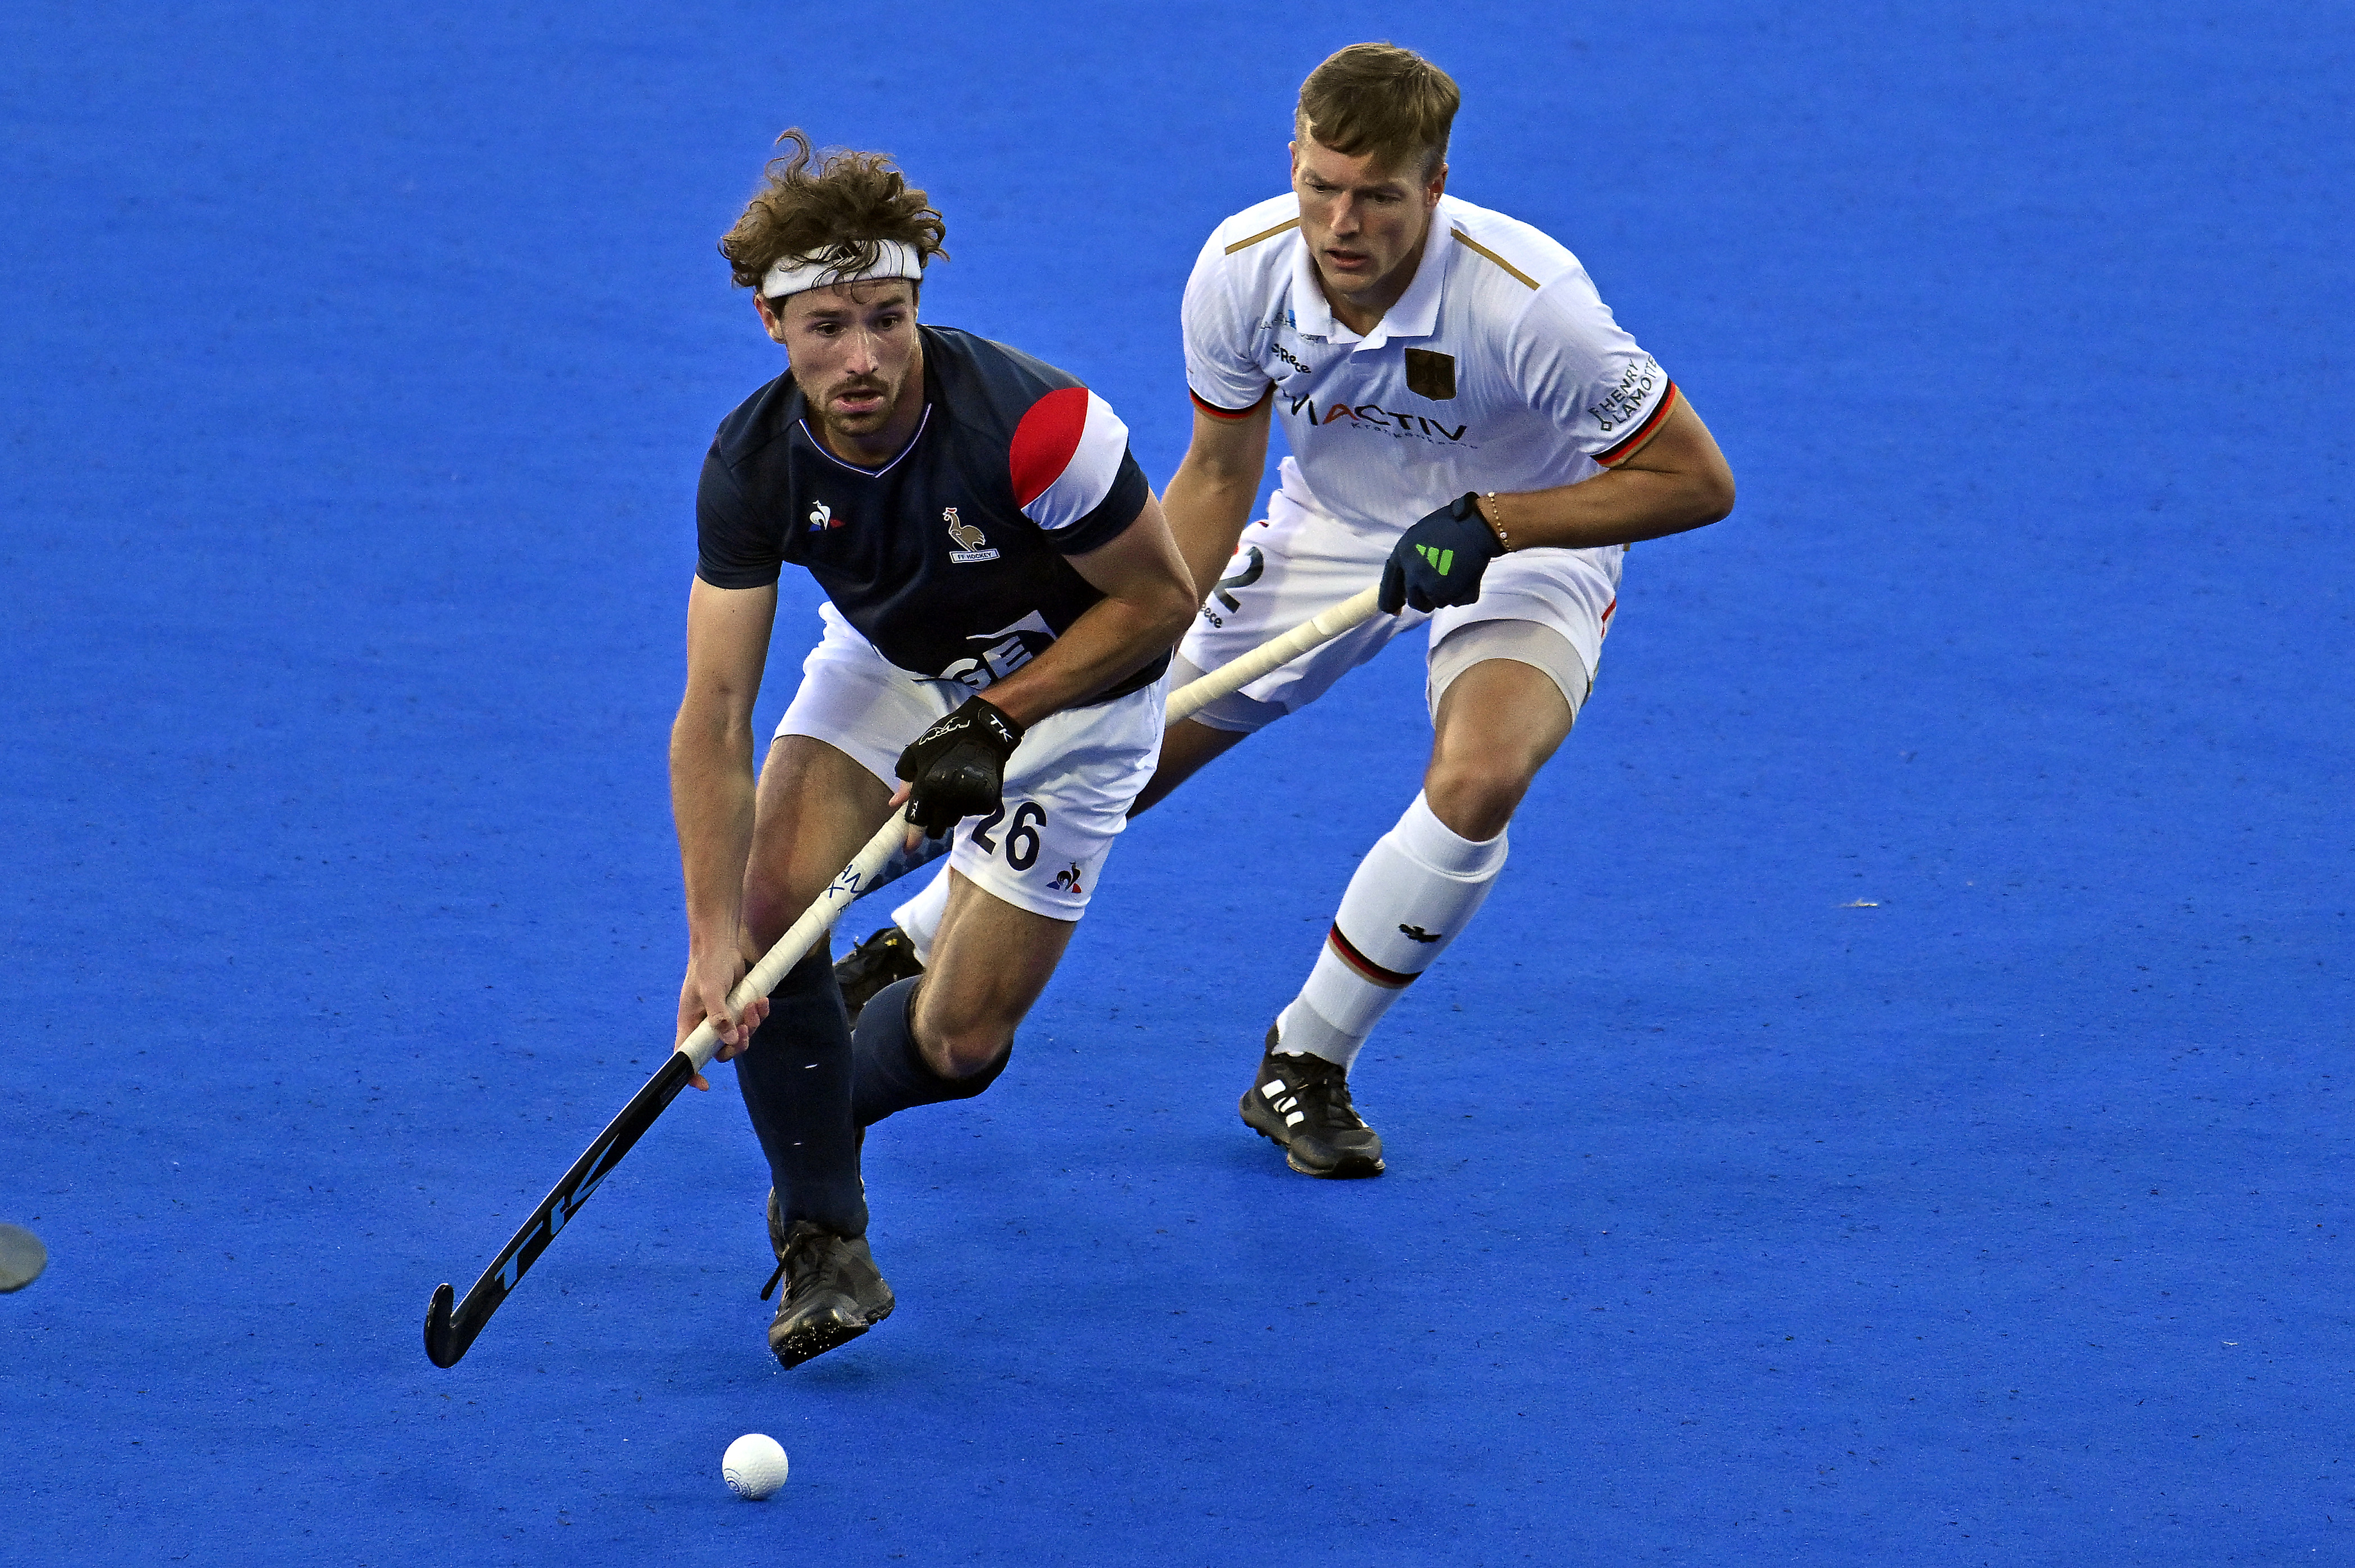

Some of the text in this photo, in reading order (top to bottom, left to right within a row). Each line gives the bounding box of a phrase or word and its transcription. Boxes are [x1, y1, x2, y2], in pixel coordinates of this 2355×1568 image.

[1282, 388, 1467, 441] VIACTIV
[1598, 358, 1638, 411] HENRY
[1612, 355, 1657, 424] LAMOTTE
[990, 714, 1014, 743] TK
[971, 802, 1047, 872] 26
[495, 1133, 619, 1291] TK
